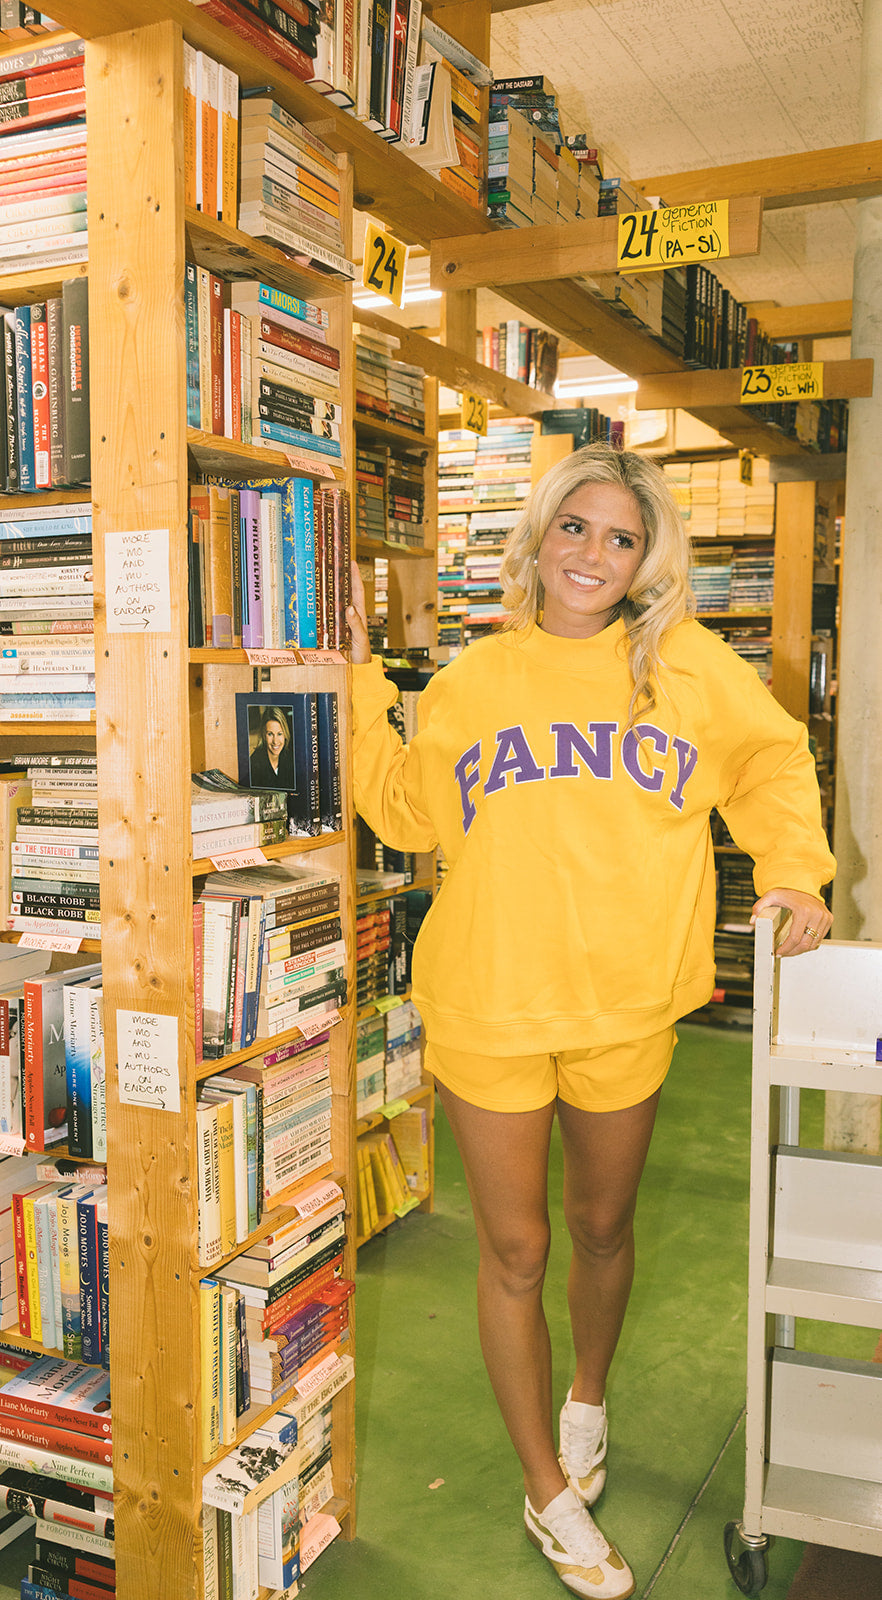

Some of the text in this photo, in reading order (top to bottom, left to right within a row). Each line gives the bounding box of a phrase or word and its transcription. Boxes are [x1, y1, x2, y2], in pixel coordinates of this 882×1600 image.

[620, 202, 718, 260] 24 general
[368, 236, 398, 295] 24
[274, 290, 300, 315] MORSI
[16, 318, 29, 362] Collected
[48, 303, 56, 354] WALKING
[38, 324, 46, 373] GRAHAM
[69, 325, 77, 391] CONSEQUENCES
[742, 368, 772, 397] 23
[51, 367, 59, 438] GATLINBURG
[467, 396, 484, 431] 23
[122, 533, 151, 544] MORE
[303, 510, 313, 552] MOSSE
[342, 496, 350, 569] SEPULCHRE
[122, 560, 145, 569] AND
[252, 518, 261, 602] PHILADELPHIA
[115, 583, 161, 594] AUTHORS
[306, 560, 315, 618] CITADEL
[113, 604, 156, 617] ENDCAP
[126, 597, 140, 606] ON
[9, 711, 43, 719] assassins
[14, 757, 30, 765] BRIAN
[30, 757, 50, 765] MOORE
[311, 735, 319, 773] MOSSE
[454, 721, 698, 837] FANCY
[25, 844, 39, 855] THE
[40, 845, 75, 857] STATEMENT
[24, 906, 83, 919] BLACK ROBE
[26, 894, 86, 907] BLACK ROBE
[32, 920, 59, 929] Appetites
[26, 991, 35, 1023] Liane
[90, 1000, 98, 1043] Moriarty
[131, 1015, 159, 1027] MORE
[26, 1025, 35, 1065] Moriarty
[132, 1039, 151, 1049] AND
[124, 1062, 171, 1077] AUTHORS
[137, 1075, 152, 1085] ON
[123, 1082, 167, 1095] ENDCAP
[76, 1169, 97, 1179] before
[80, 1212, 89, 1268] JOJO MOYES
[101, 1226, 109, 1247] JOJO
[18, 1261, 25, 1275] Me
[60, 1203, 69, 1225] Jojo
[66, 1333, 75, 1359] Stars
[86, 1294, 94, 1327] Someone
[212, 1336, 218, 1346] OF
[28, 1361, 69, 1387] Liane
[37, 1363, 88, 1398] Moriar
[307, 1372, 348, 1412] THE BIG WAR
[0, 1398, 99, 1429] Liane Moriarty Apples Never Fall
[16, 1427, 50, 1448] Moriarty
[55, 1441, 73, 1452] Apples
[74, 1445, 89, 1455] Never
[90, 1449, 100, 1459] Fall
[0, 1445, 96, 1479] Liane Nine Perfect
[55, 1472, 90, 1486] Strangers
[46, 1524, 113, 1549] FORGOTTEN GARDEN
[204, 1528, 214, 1542] A
[47, 1558, 69, 1569] CIRCUS
[49, 1552, 68, 1564] NIGHT
[204, 1540, 216, 1580] GREEN
[40, 1580, 62, 1592] CIRCUS
[41, 1573, 60, 1585] NIGHT
